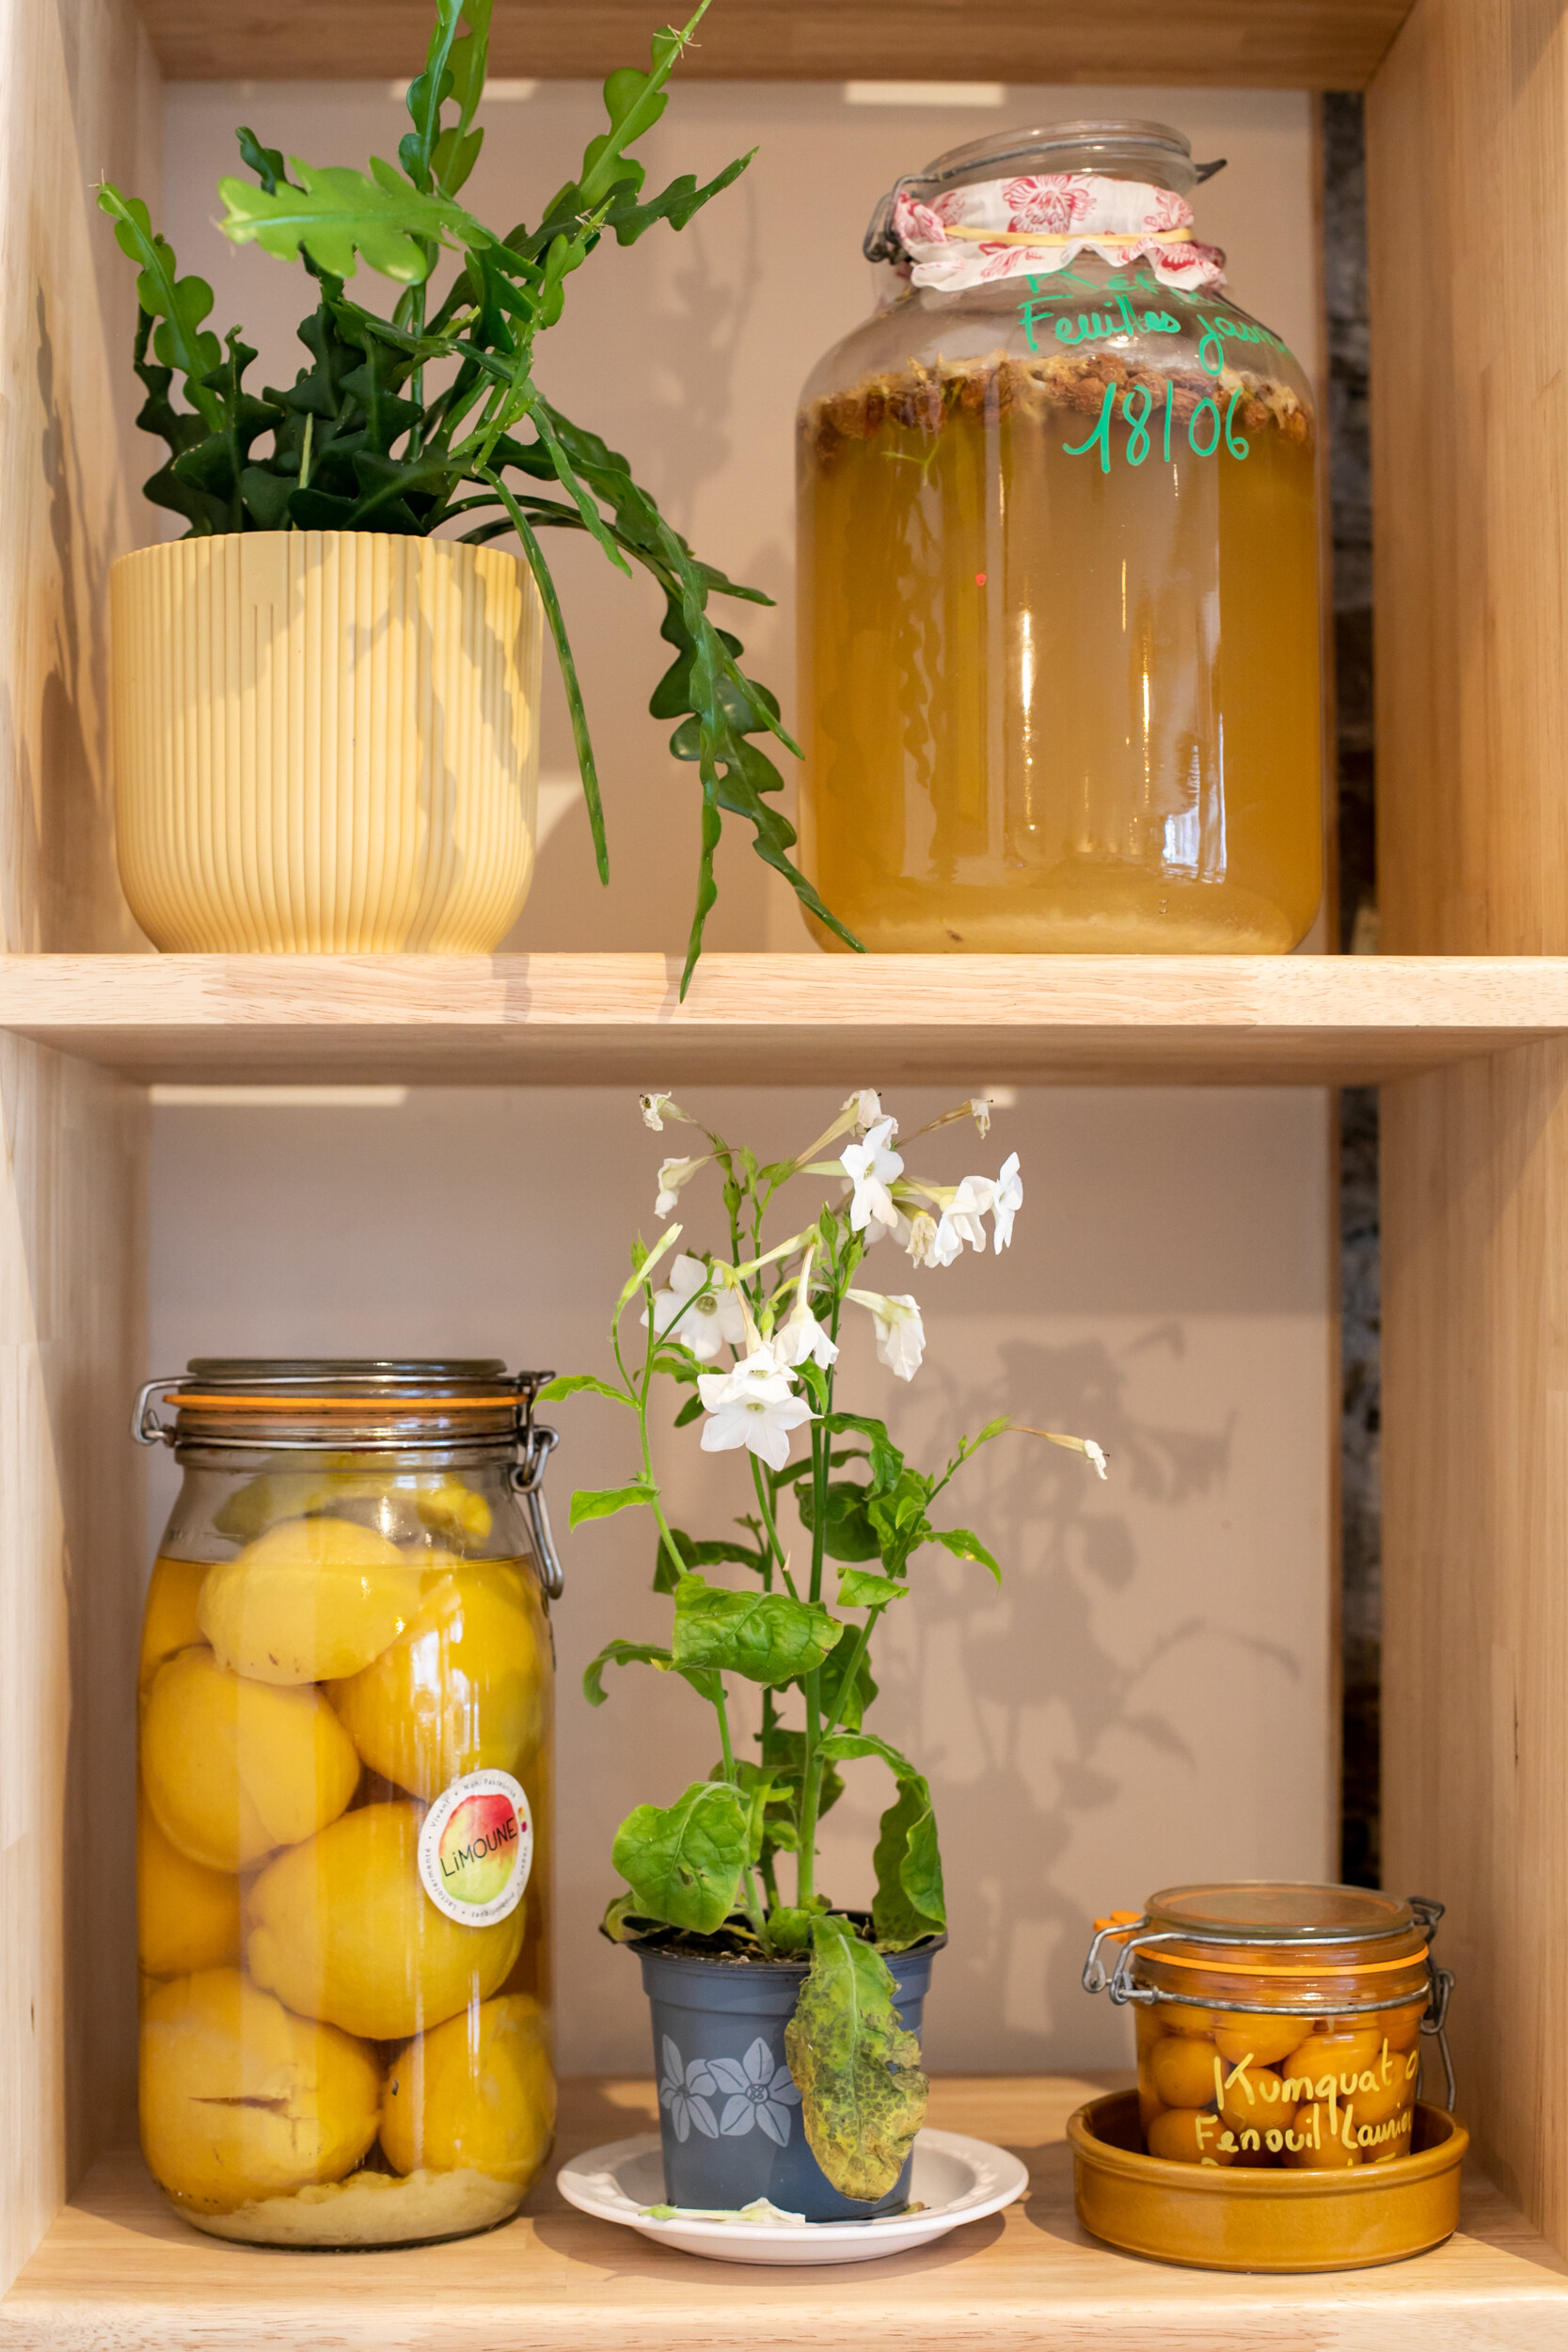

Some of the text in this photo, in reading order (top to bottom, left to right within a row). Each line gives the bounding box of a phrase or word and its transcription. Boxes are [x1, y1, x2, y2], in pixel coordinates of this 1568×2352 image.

[1017, 294, 1181, 353] Feuilles
[430, 1799, 451, 1828] Vivant
[1212, 2037, 1393, 2136] Kumquat
[1194, 2102, 1322, 2153] Fenouil
